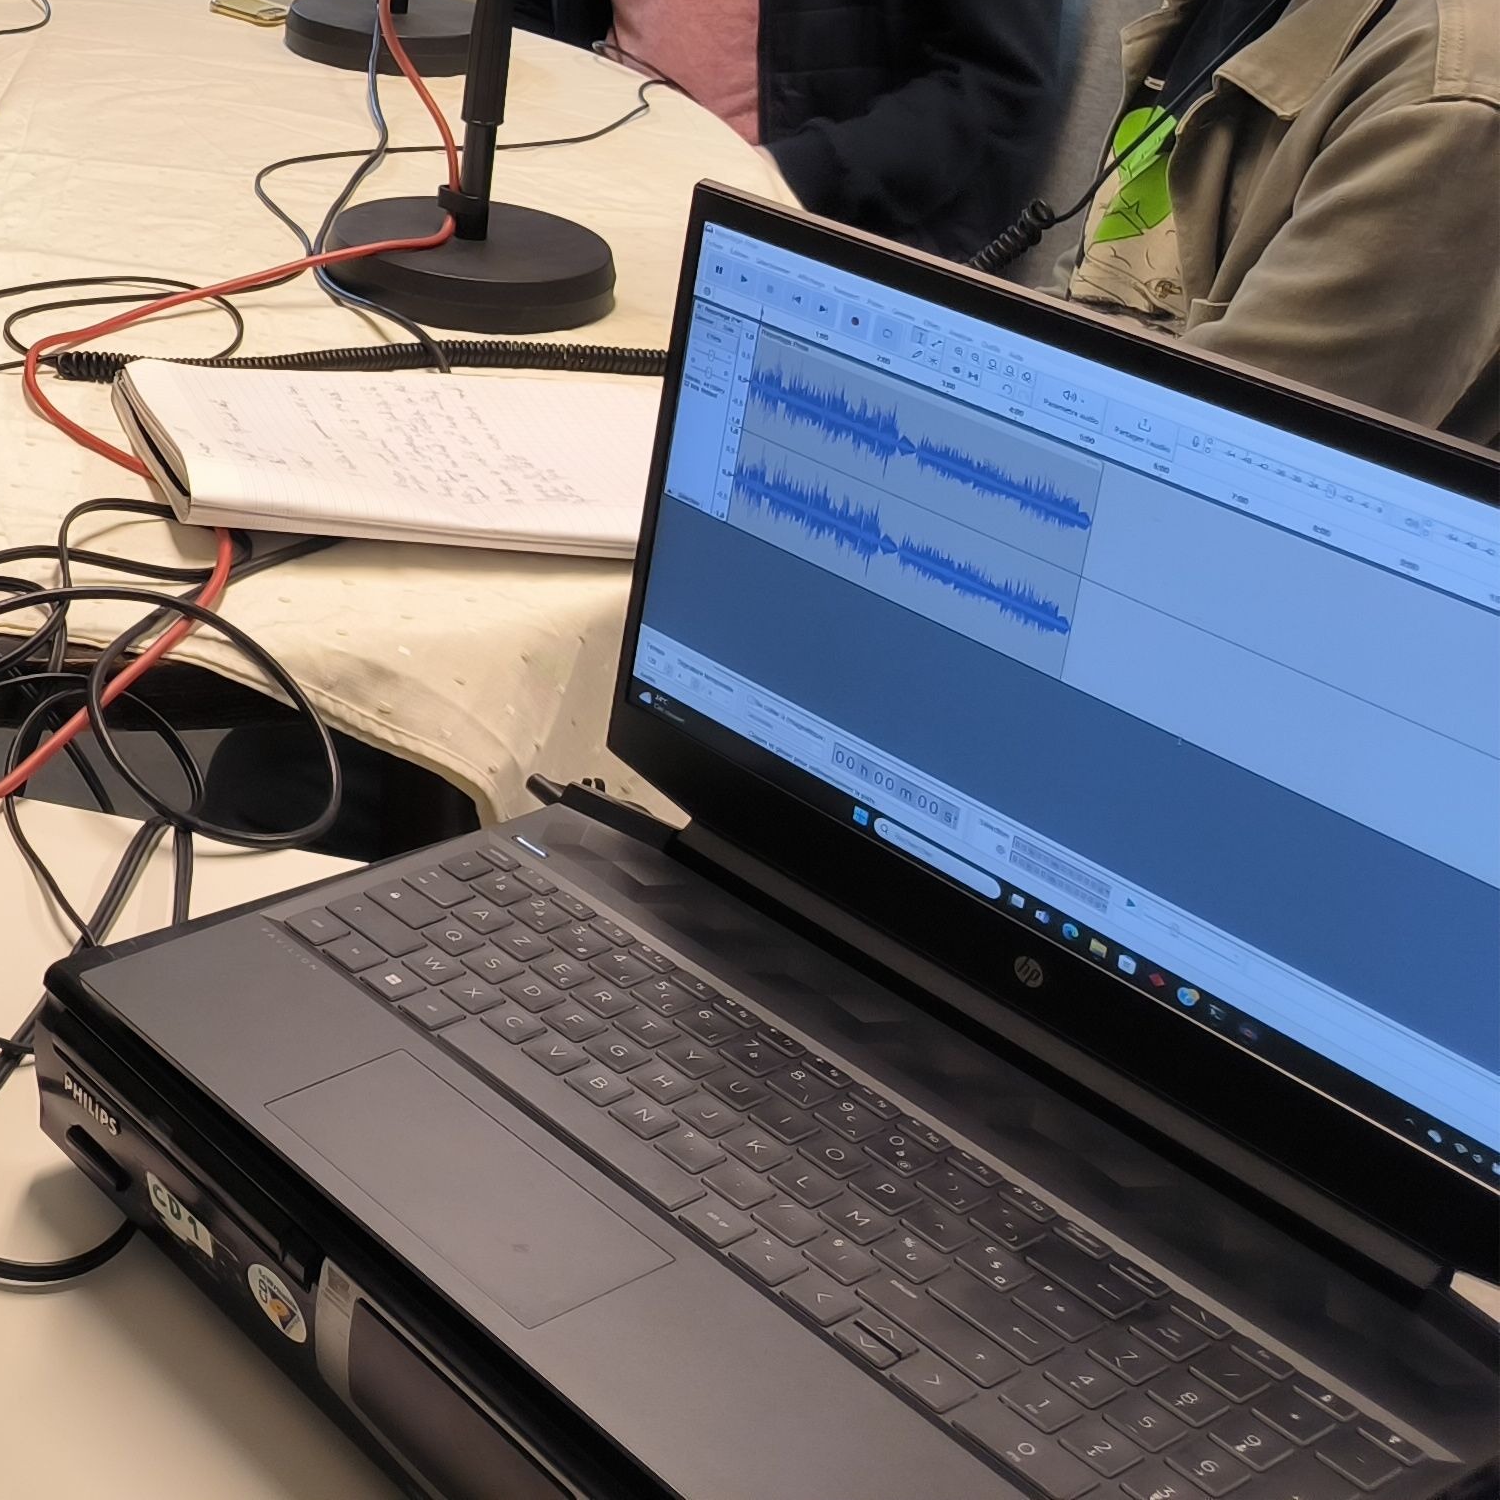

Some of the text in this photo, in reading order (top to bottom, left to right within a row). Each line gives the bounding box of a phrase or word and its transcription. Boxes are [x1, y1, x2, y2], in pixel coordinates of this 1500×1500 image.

[530, 900, 546, 909] 2
[473, 910, 489, 920] A
[445, 930, 462, 942] Q
[512, 937, 531, 946] Z
[425, 957, 446, 971] W
[485, 958, 501, 969] S
[613, 954, 627, 963] 4
[553, 963, 572, 974] E
[1016, 957, 1042, 987] hp
[523, 986, 541, 996] D
[654, 981, 671, 990] 5
[463, 988, 483, 998] X
[594, 991, 613, 1002] R
[565, 1014, 585, 1027] F
[698, 1010, 713, 1019] 6
[505, 1016, 523, 1029] C
[641, 1021, 658, 1031] T
[548, 1045, 567, 1058] V
[609, 1045, 629, 1058] G
[686, 1050, 703, 1060] Y
[589, 1078, 609, 1090] B
[653, 1075, 674, 1088] H
[729, 1081, 749, 1093] U
[64, 1073, 119, 1137] PHILIPS
[633, 1108, 655, 1122] N
[700, 1111, 719, 1119] J
[746, 1139, 768, 1155] K
[825, 1148, 845, 1160] O
[796, 1174, 809, 1189] L
[875, 1183, 896, 1194] P
[153, 1184, 182, 1221] CD
[845, 1210, 870, 1226] M
